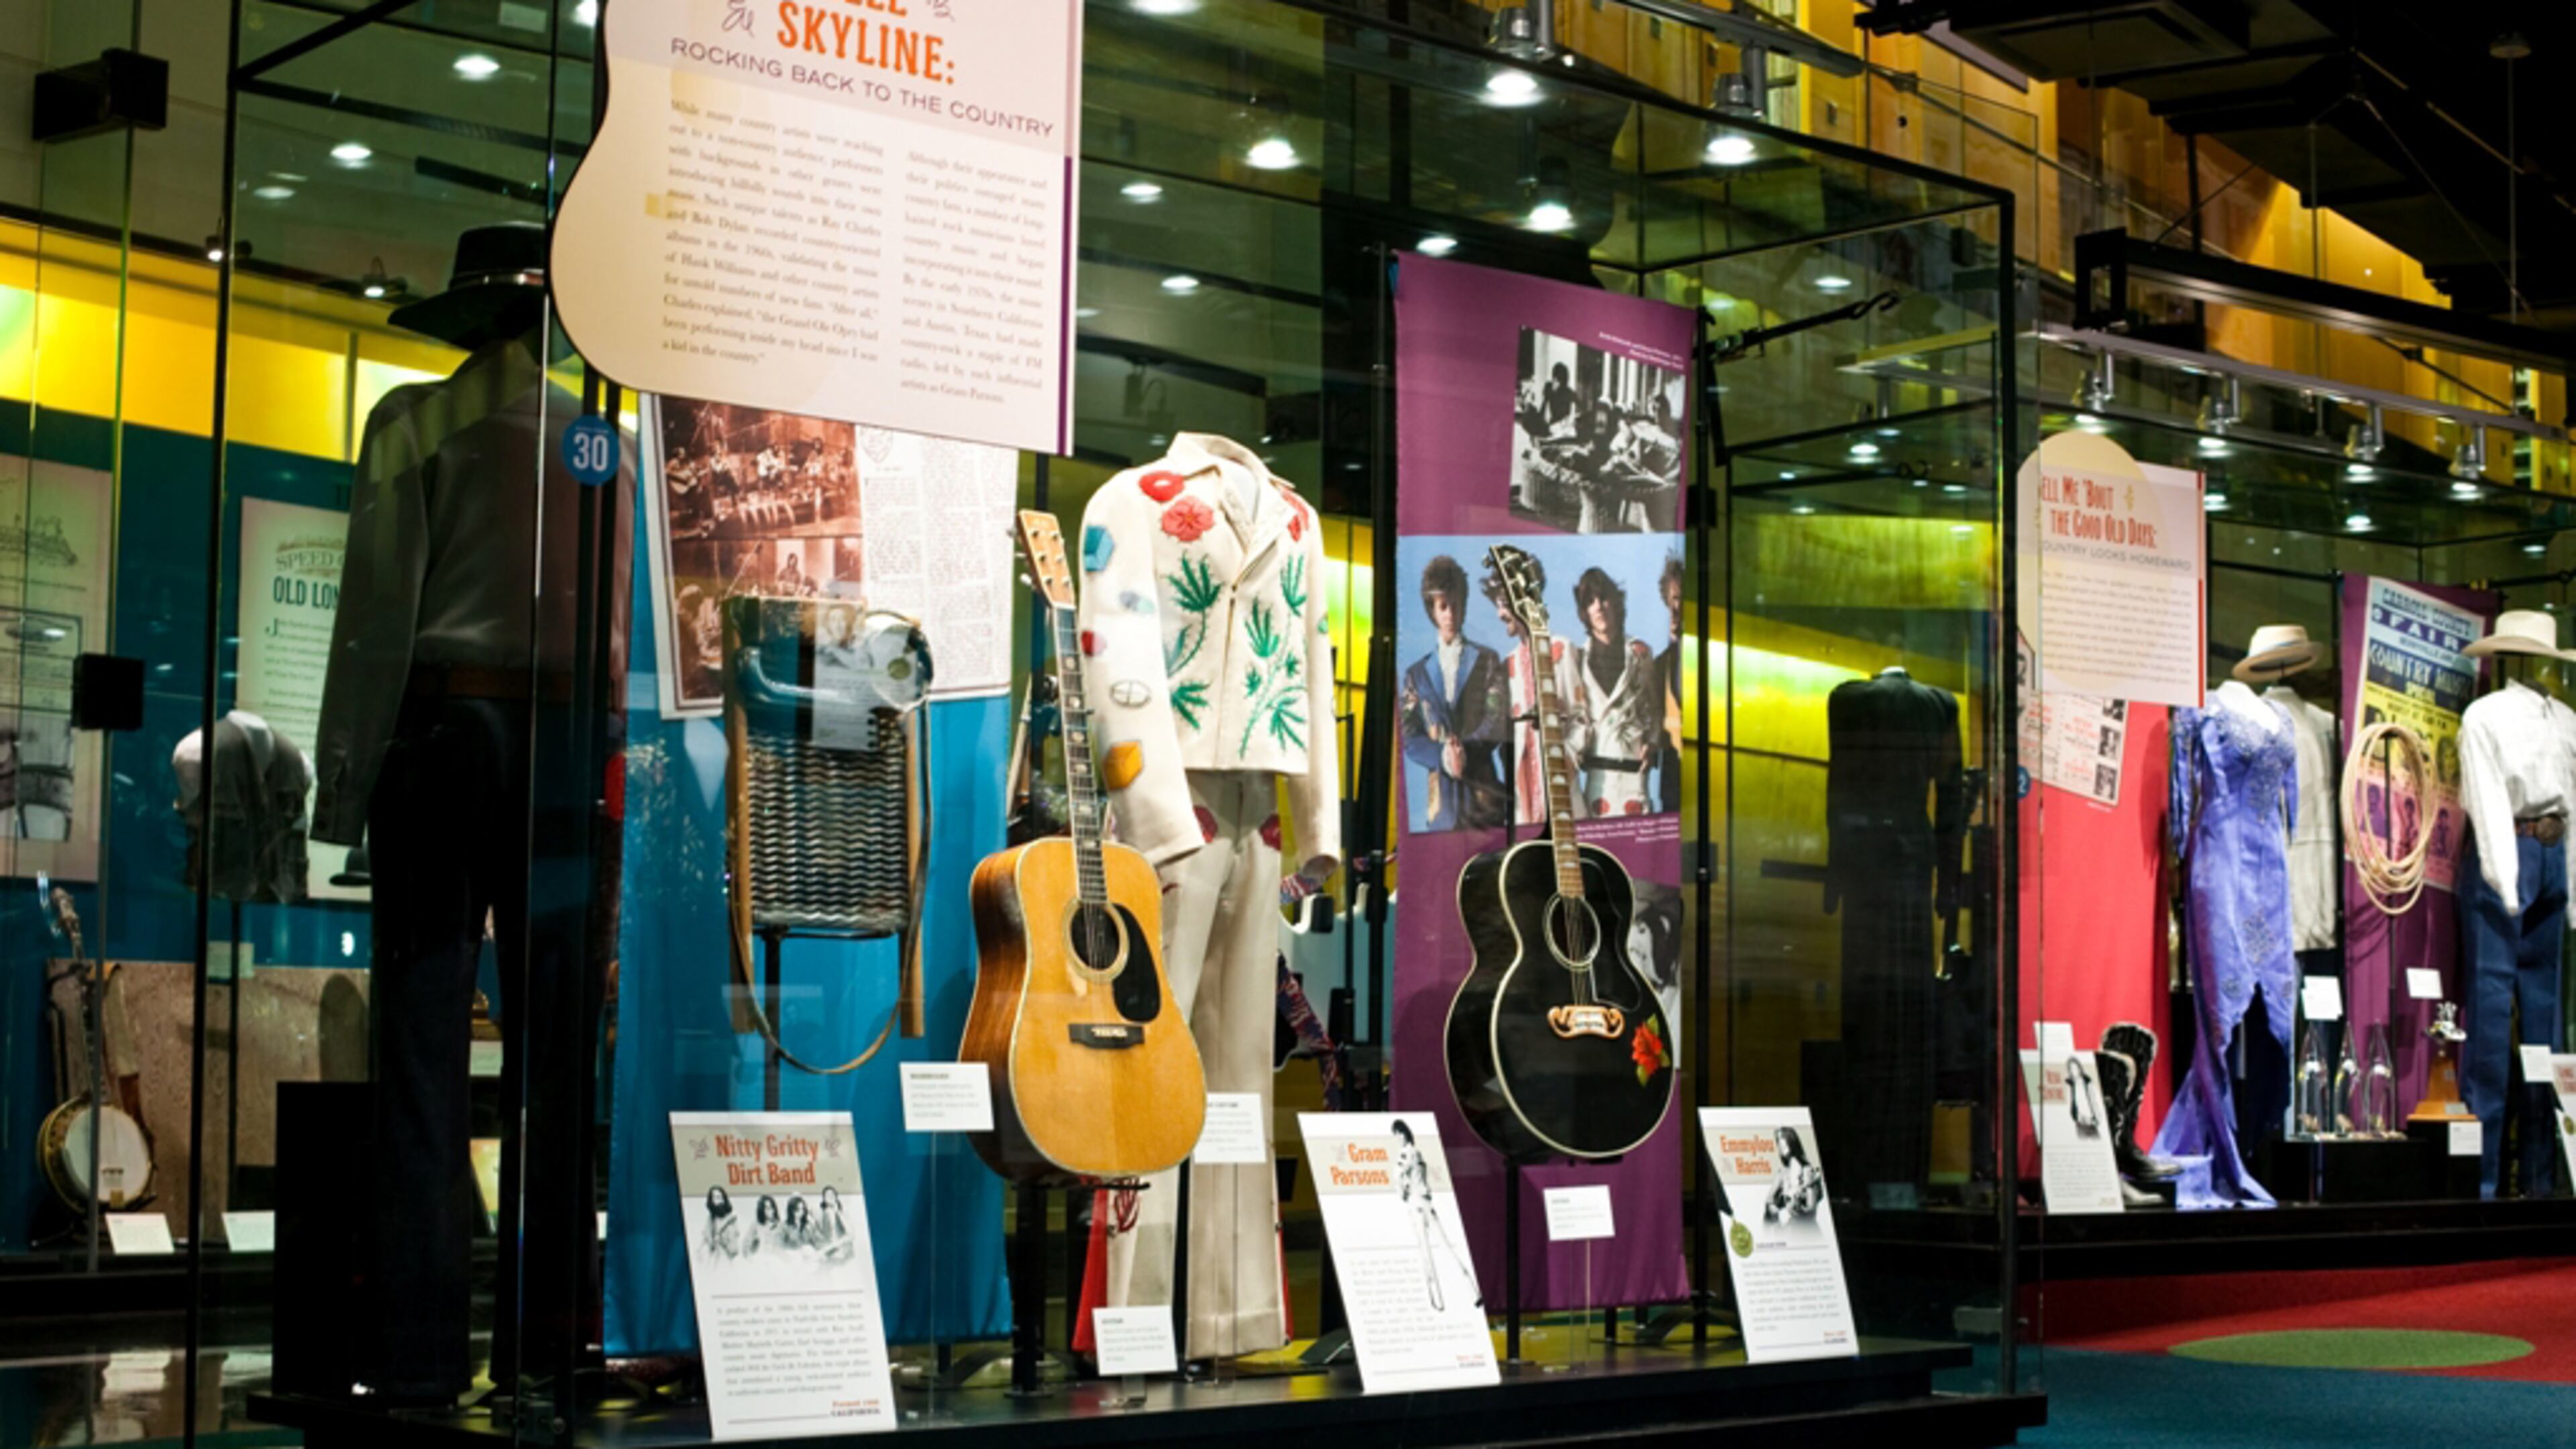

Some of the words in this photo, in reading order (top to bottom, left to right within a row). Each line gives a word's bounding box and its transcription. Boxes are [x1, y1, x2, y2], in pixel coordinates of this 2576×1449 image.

[777, 0, 954, 85] SKYLINE:
[672, 38, 783, 77] ROCKING
[792, 64, 853, 94] BACK
[863, 80, 891, 101] TO
[900, 89, 942, 113] THE
[950, 101, 1055, 138] COUNTRY
[573, 432, 608, 471] 30
[2042, 475, 2059, 502] ELL
[2043, 540, 2087, 555] OUNTRY
[274, 575, 307, 606] OLD
[715, 1134, 761, 1162] Nitty
[766, 1134, 818, 1161] Gritty
[1348, 1142, 1388, 1163] Gram
[1720, 1134, 1774, 1157] Emmylou
[727, 1163, 763, 1185] Dirt
[767, 1162, 816, 1185] Band
[1330, 1165, 1389, 1185] Parsons
